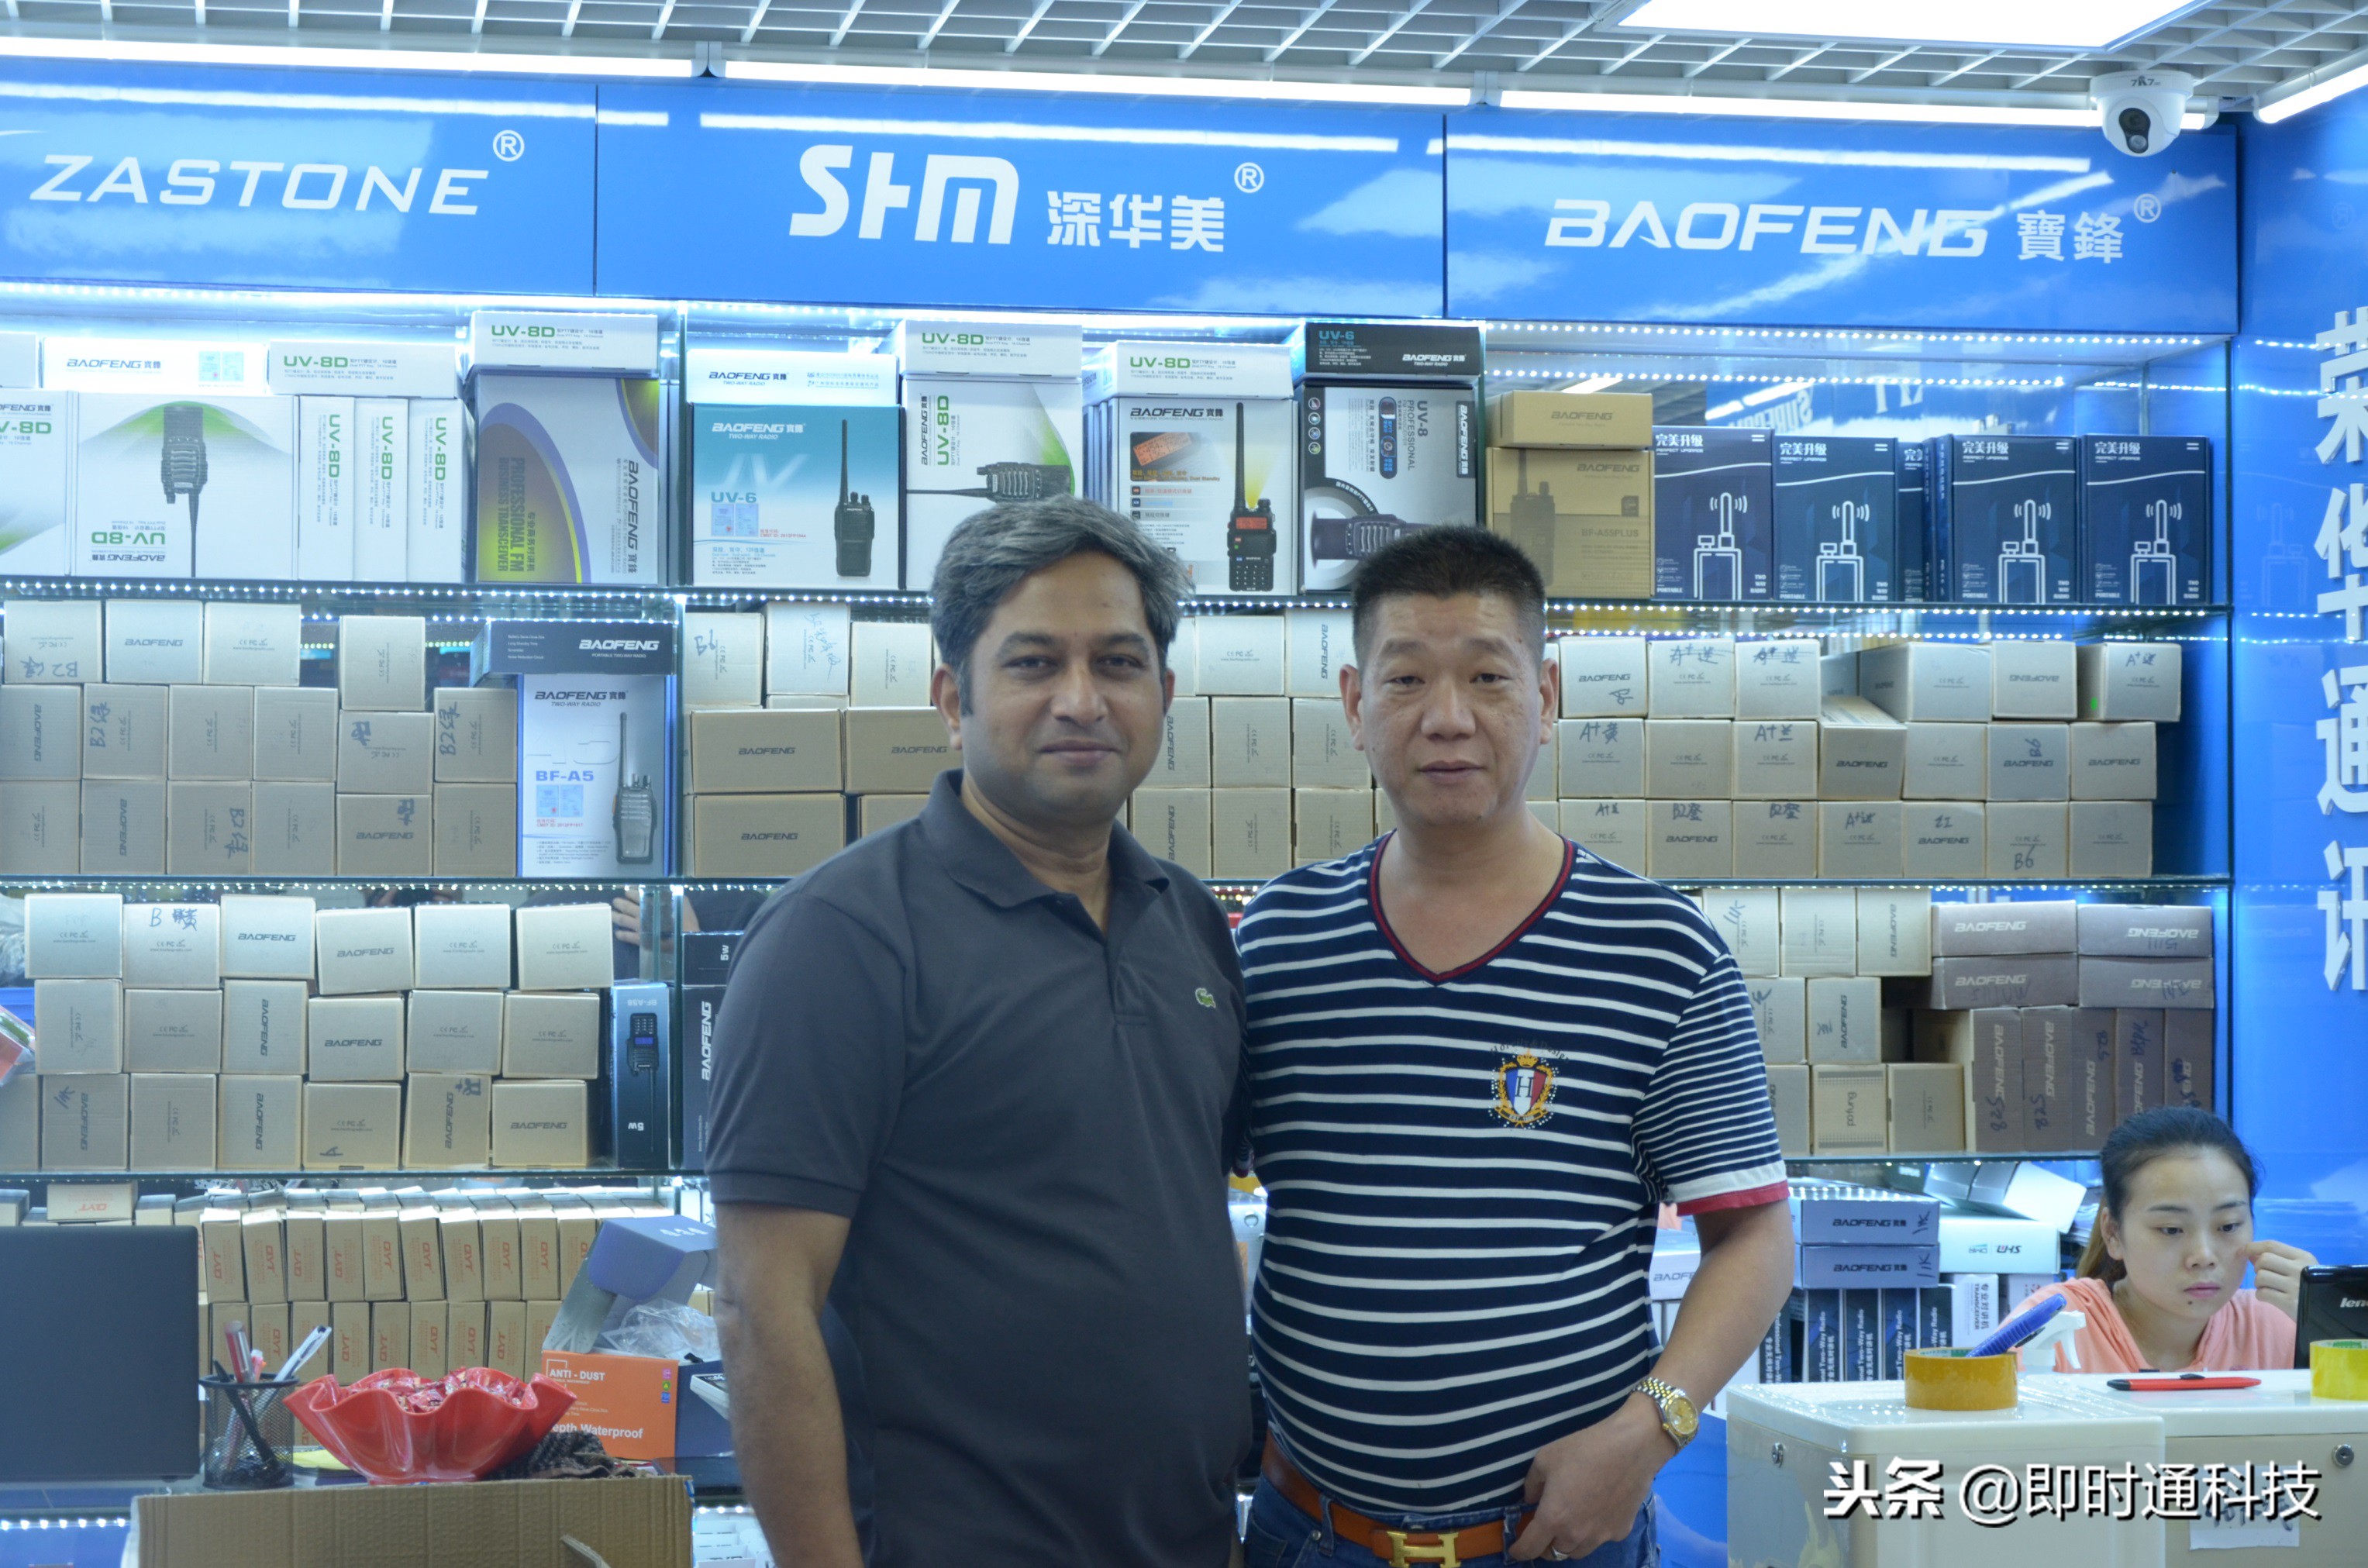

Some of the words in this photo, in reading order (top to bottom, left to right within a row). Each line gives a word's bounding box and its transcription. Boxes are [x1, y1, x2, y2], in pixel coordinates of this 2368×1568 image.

[29, 154, 489, 215] ZASTONE
[789, 144, 1019, 244] SHM
[1047, 191, 1225, 253] 深华美
[1544, 198, 1995, 258] BAOFENG
[2017, 209, 2125, 264] 寶鋒
[491, 326, 555, 337] UV-8D
[1318, 330, 1355, 340] UV-6
[922, 333, 984, 345] UV-8D
[67, 359, 142, 369] BAOFENG
[284, 356, 348, 368] UV-8D
[1130, 357, 1191, 368] UV-8D
[1402, 353, 1452, 362] BAOFENG
[708, 371, 770, 381] BAOFENG
[1130, 408, 1204, 417] BAOFENG
[1417, 400, 1429, 437] UV-8
[1551, 411, 1613, 420] BAOFENG
[0, 421, 52, 434] V-8D
[712, 422, 784, 433] BAOFENG
[937, 395, 950, 466] UV-8D
[1460, 405, 1469, 460] BAOFENG
[1407, 399, 1415, 471] PROFESSIONAL
[1656, 433, 1703, 447] 完美升级
[329, 414, 340, 477] UV-8D
[381, 416, 393, 480] UV-8D
[435, 417, 446, 481] UV-8D
[1780, 442, 1827, 456] 完美升级
[1962, 441, 2009, 455] 完美升级
[2095, 441, 2141, 455] 完美升级
[1577, 464, 1640, 472] BAOFENG
[498, 457, 509, 505] BUSINESS
[510, 457, 526, 550] PROFESSIONAL
[711, 491, 757, 503] UV-6
[628, 460, 639, 551] BAOFENG
[91, 532, 165, 545] UV-8D
[498, 508, 509, 572] TRANSCEIVER
[510, 553, 524, 572] FM
[579, 639, 660, 650] BAOFENG
[1578, 674, 1631, 682] BAOFENG
[2009, 674, 2060, 683] BAOFENG
[534, 691, 607, 700] BAOFENG
[1167, 715, 1175, 771] BAOFENG
[891, 746, 948, 754] BAOFENG
[1836, 760, 1888, 769] BAOFENG
[2004, 760, 2054, 768] BAOFENG
[2088, 758, 2141, 767] BAOFENG
[536, 770, 594, 782] BF-A5
[356, 832, 414, 840] BAOFENG
[741, 832, 798, 841] BAOFENG
[1918, 837, 1970, 846] BAOFENG
[1955, 921, 2028, 932] BAOFENG
[237, 932, 296, 942] BAOFENG
[2127, 928, 2200, 939] BAOFENG
[336, 947, 395, 957] BAOFENG
[1955, 974, 2028, 987] BAOFENG
[260, 998, 269, 1056] BAOFENG
[324, 1039, 383, 1047] BAOFENG
[701, 1001, 712, 1081] BAOFENG
[2045, 1021, 2055, 1098] BAOFENG
[1515, 1076, 1535, 1098] H
[2134, 1062, 2143, 1114] OFENG
[2086, 1060, 2096, 1136] BAOFENG
[80, 1092, 88, 1151] BAOFENG
[255, 1093, 264, 1151] BAOFENG
[445, 1091, 453, 1149] BAOFENG
[1832, 1218, 1891, 1227] BAOFENG
[1833, 1263, 1892, 1272] BAOFENG
[1980, 1283, 1990, 1330] 专业对讲机
[549, 1369, 572, 1378] ANTI
[580, 1370, 605, 1381] DUST
[552, 1423, 577, 1434] epth
[581, 1424, 643, 1439] Waterproof
